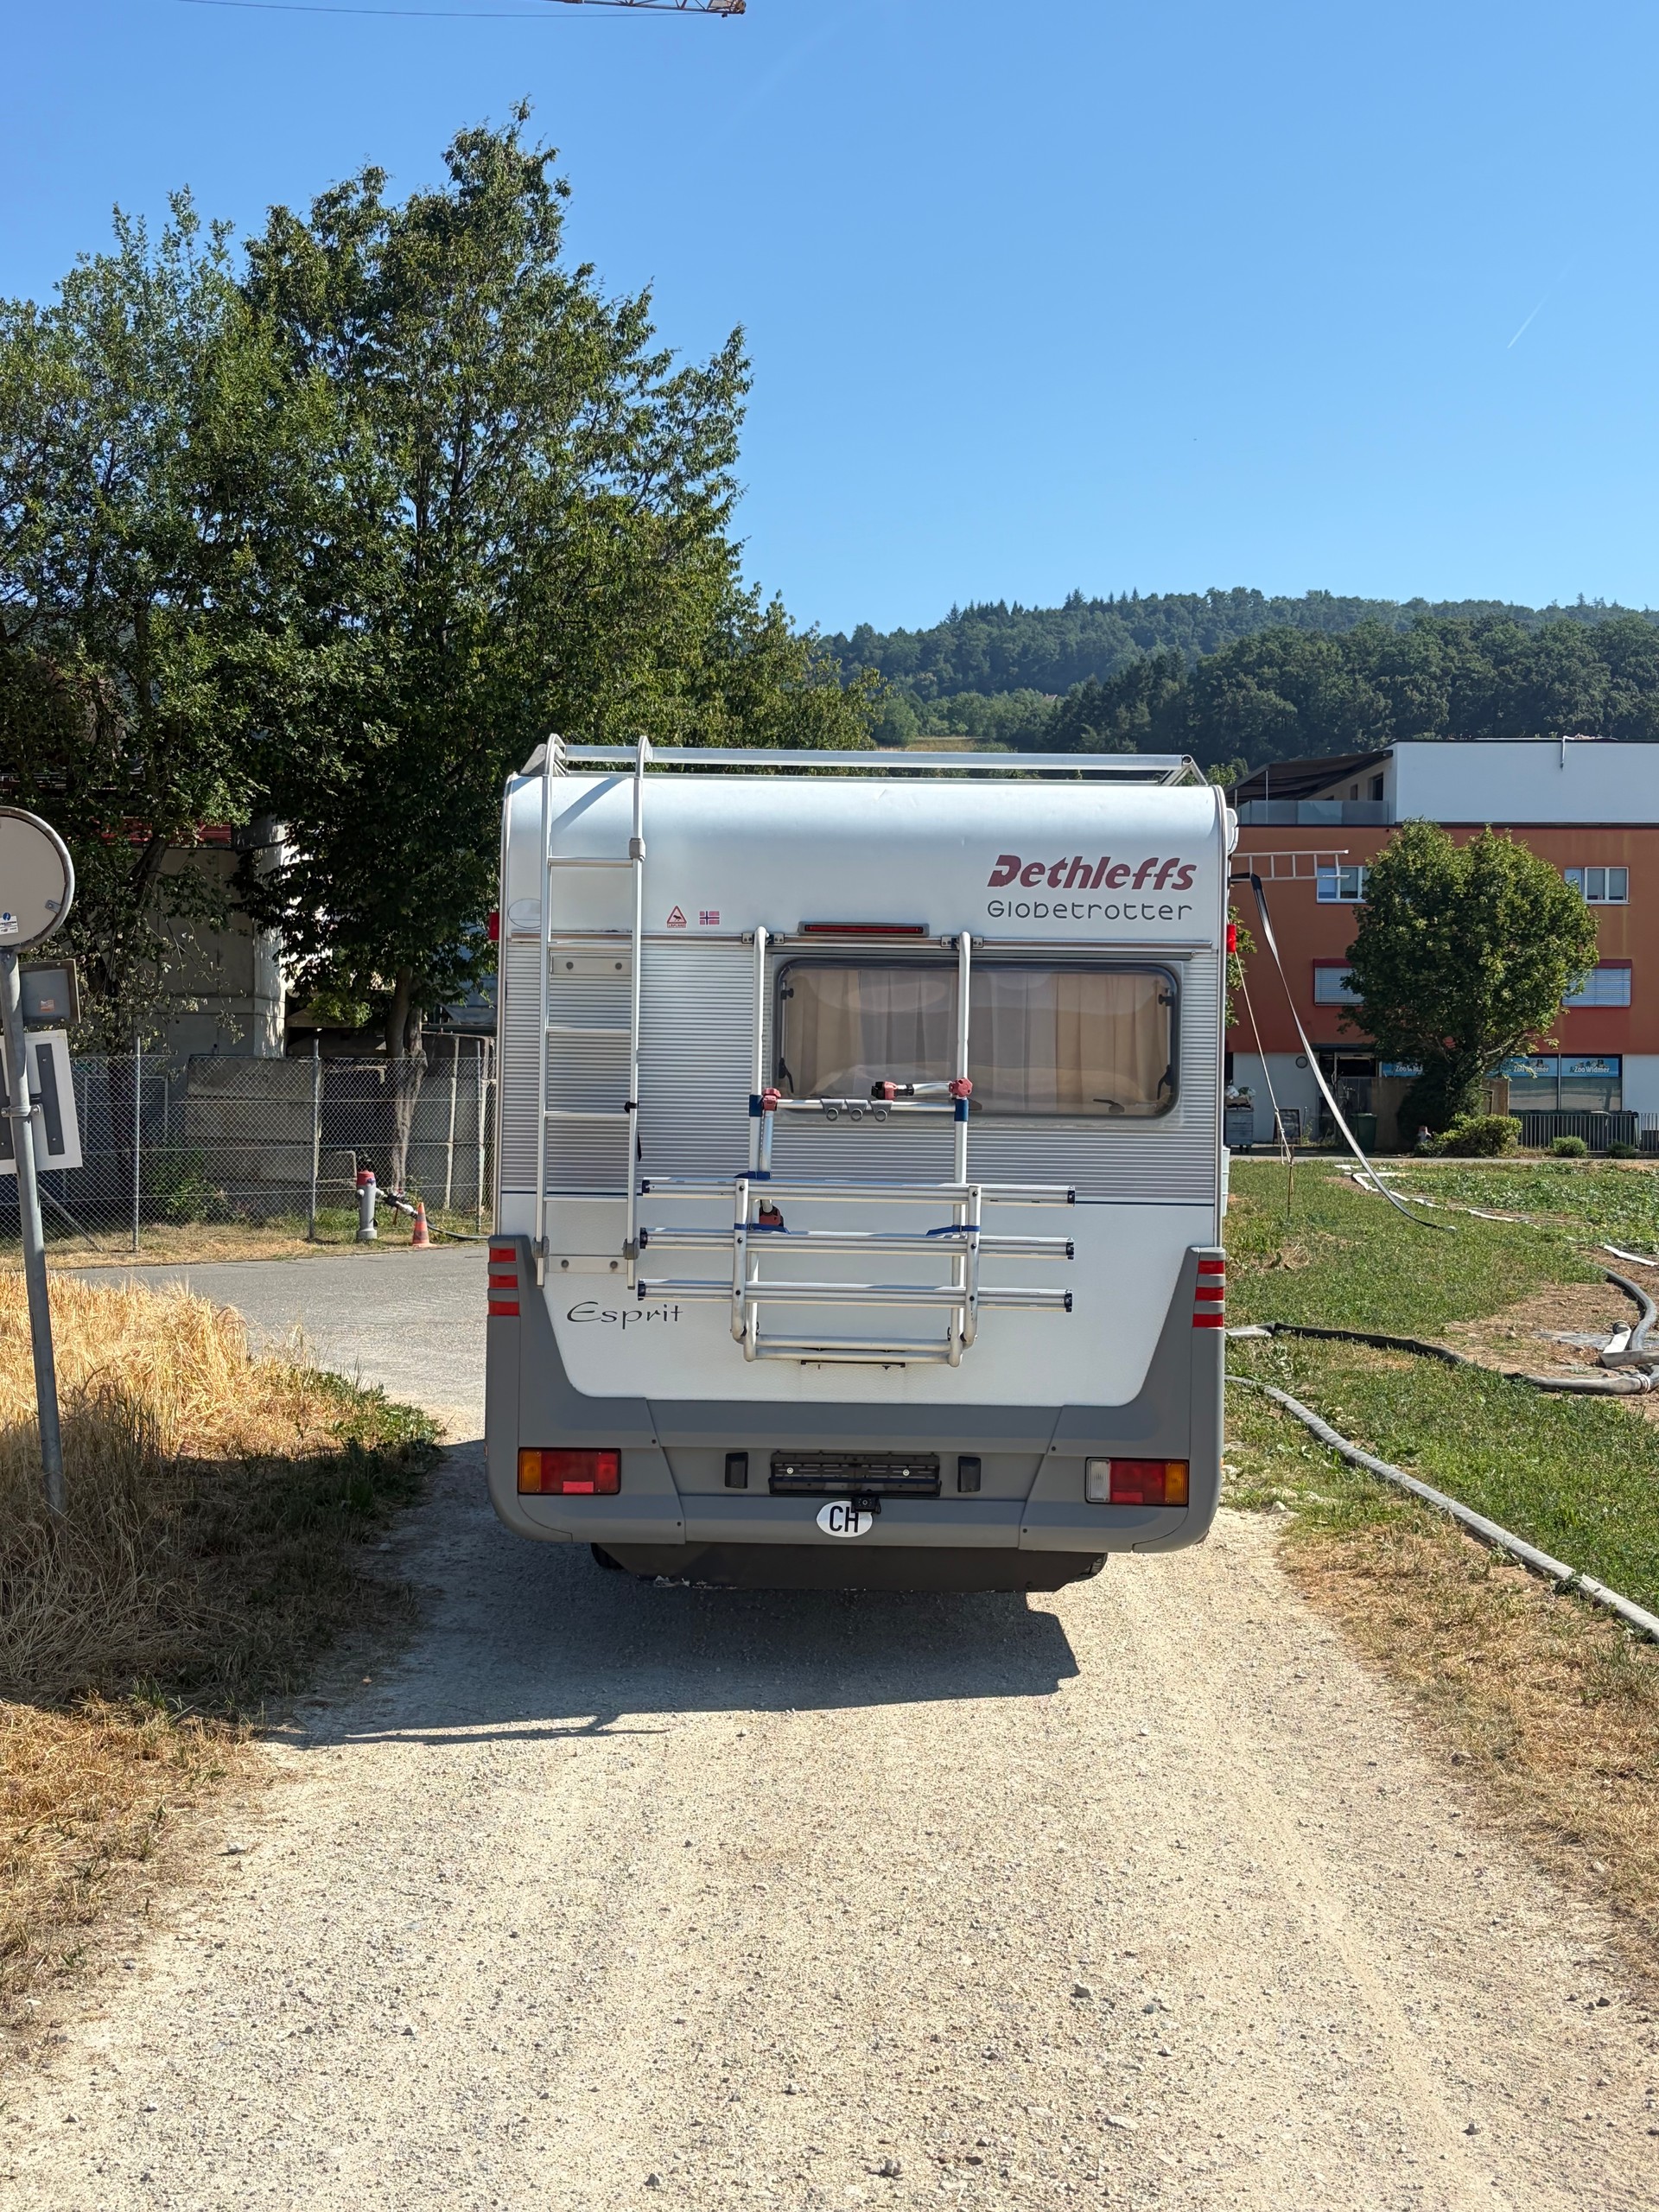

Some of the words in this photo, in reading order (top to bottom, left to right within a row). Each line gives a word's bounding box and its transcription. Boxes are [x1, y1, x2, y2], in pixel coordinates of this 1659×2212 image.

[987, 855, 1198, 891] Dethleffs
[987, 899, 1193, 920] Globetrotter
[567, 1301, 683, 1330] Esprit
[830, 1505, 860, 1533] CH
